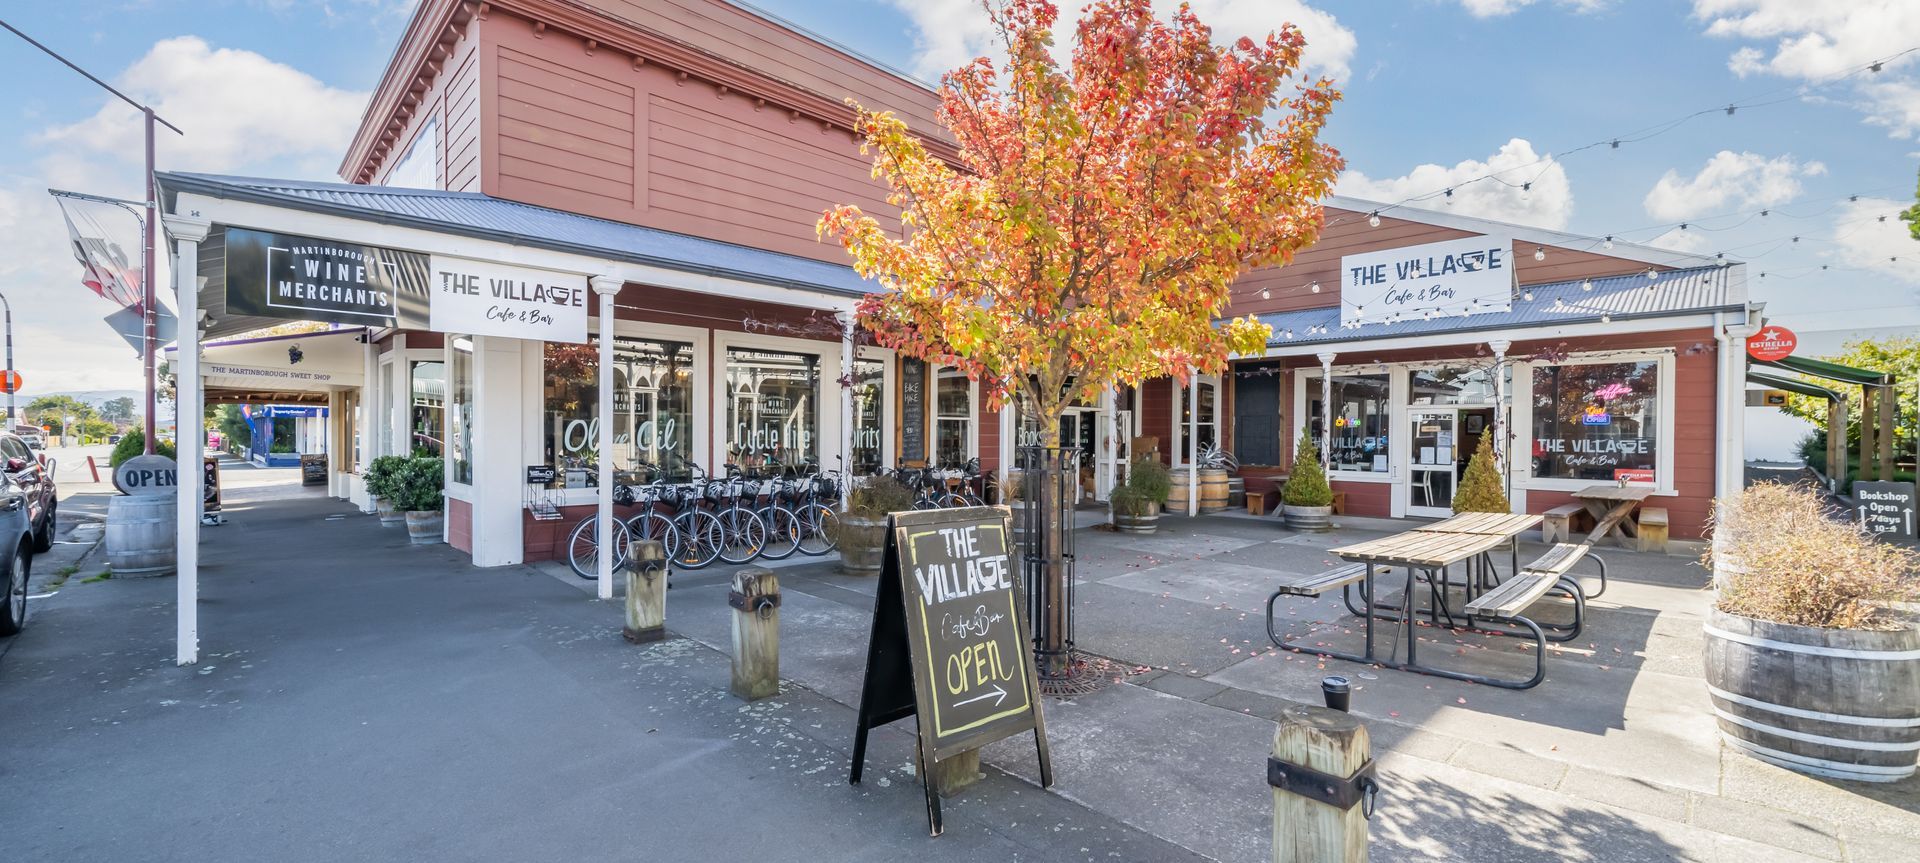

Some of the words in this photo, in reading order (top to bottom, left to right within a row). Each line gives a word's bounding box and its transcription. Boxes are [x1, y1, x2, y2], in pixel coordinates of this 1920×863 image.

[292, 246, 375, 265] MARTINBOROUGH
[304, 259, 365, 283] WINE
[1351, 264, 1386, 286] THE
[1396, 248, 1502, 281] VILLAGE
[279, 280, 388, 307] MERCHANTS
[439, 271, 480, 296] THE
[489, 278, 583, 307] VILLAGE
[1385, 288, 1414, 305] Cafe
[1417, 289, 1426, 300] &
[1428, 284, 1456, 300] Bar
[486, 305, 516, 322] Cafe
[519, 310, 527, 322] &
[529, 309, 554, 325] Bar
[1750, 340, 1793, 348] ESTRELLA
[211, 366, 226, 374] THE
[228, 367, 288, 378] MARTINBOROUGH
[738, 422, 779, 454] Cycle
[1537, 438, 1565, 453] THE
[1571, 439, 1648, 454] VILLAGE
[1566, 454, 1587, 466] Cafe
[1596, 454, 1619, 466] Bar
[125, 468, 177, 488] OPEN
[1859, 489, 1909, 503] Bookshop
[1869, 501, 1898, 514] Open
[938, 525, 981, 559] THE
[914, 554, 1012, 606] VILLAGE
[974, 604, 1005, 637] Bar
